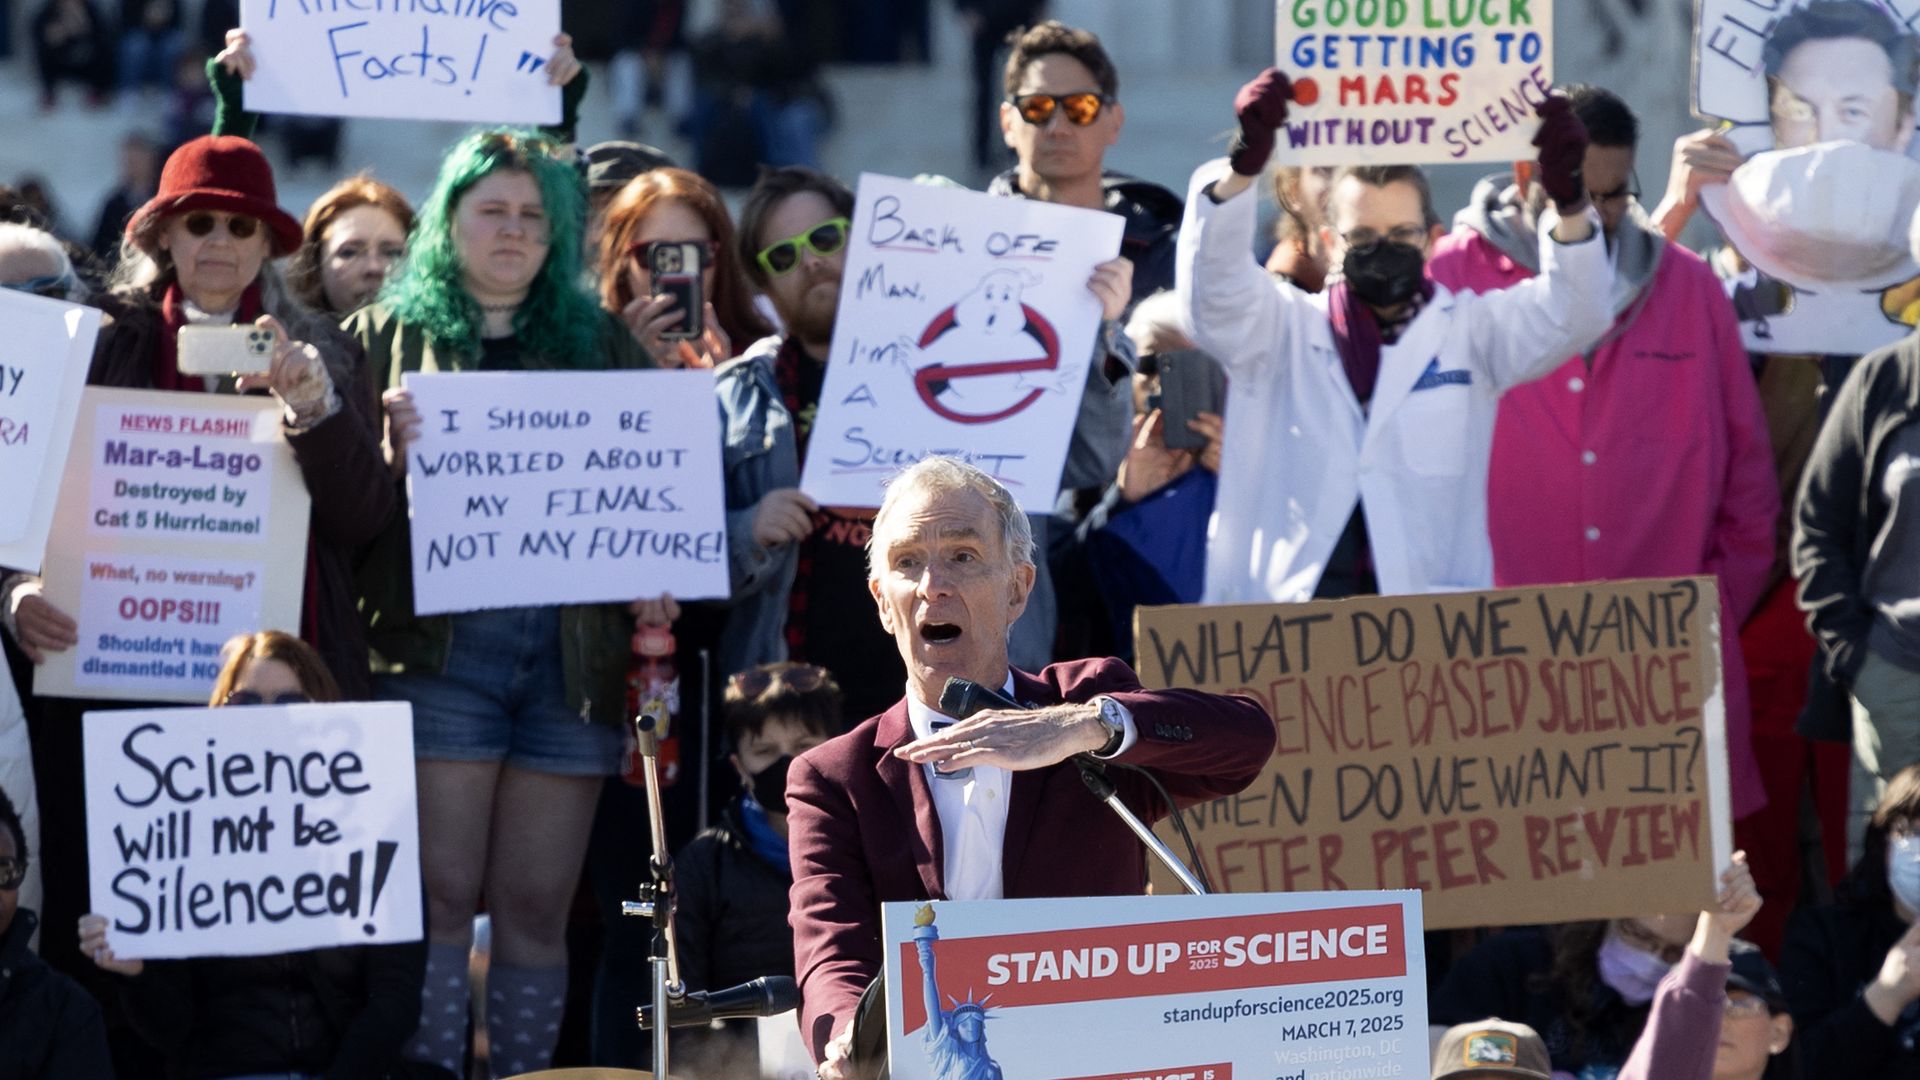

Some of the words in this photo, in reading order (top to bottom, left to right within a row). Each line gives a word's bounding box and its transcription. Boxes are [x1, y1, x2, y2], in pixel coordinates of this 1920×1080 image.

[268, 0, 518, 31] rnaive
[1291, 0, 1408, 28] GOOD
[1423, 0, 1532, 28] LUCK
[327, 21, 488, 98] Facts!
[1291, 33, 1476, 68] GETTING
[1495, 31, 1543, 64] TO
[1339, 72, 1461, 107] MARS
[1285, 117, 1435, 149] WITHOUT
[1444, 64, 1553, 158] SCIENCE
[0, 364, 24, 397] Y
[841, 384, 878, 408] A
[120, 414, 174, 432] NEWS
[179, 416, 249, 436] FLASH!!
[440, 409, 461, 433] I
[487, 408, 592, 432] SHOULD
[619, 409, 653, 433] BE
[104, 441, 262, 476] Mar-a-Lago
[416, 451, 565, 478] WORRIED
[584, 448, 688, 472] ABOUT
[114, 480, 217, 505] Destroyed
[223, 485, 248, 507] by
[465, 494, 510, 519] MY
[545, 485, 684, 517] FINALS.
[94, 509, 129, 528] Cat
[135, 511, 148, 529] 5
[154, 511, 261, 534] Hurricane!
[426, 531, 503, 573] NOT
[519, 530, 577, 561] MY
[586, 526, 725, 563] FUTURE!
[90, 562, 140, 584] What,
[146, 568, 168, 583] no
[173, 569, 256, 592] warning?
[118, 595, 222, 625] OOPS!!!
[98, 633, 185, 656] Shouldn't
[191, 637, 224, 657] hav
[1148, 611, 1333, 687] WHAT
[1351, 607, 1416, 668] DO
[1435, 597, 1528, 659] WE
[1537, 580, 1701, 657] WANT?
[83, 656, 187, 679] dismantled
[1400, 657, 1531, 746] BASED
[1538, 652, 1702, 735] SCIENCE
[113, 722, 371, 808] Science
[1336, 764, 1402, 823] DO
[1412, 756, 1482, 816] WE
[1488, 742, 1622, 809] WANT
[1628, 726, 1702, 795] IT?
[113, 809, 191, 866] will
[212, 805, 275, 856] not
[294, 803, 343, 847] be
[1371, 817, 1508, 893] PEER
[1524, 799, 1702, 882] REVIEW
[111, 841, 399, 937] Silenced!
[986, 947, 1119, 987] STAND
[1127, 942, 1181, 976] UP
[1187, 940, 1221, 955] FOR
[1223, 924, 1388, 968] SCIENCE
[1189, 958, 1219, 971] 2025
[1163, 986, 1404, 1025] standupforscience2025.org
[1282, 1020, 1341, 1041] MARCH
[1345, 1019, 1357, 1038] 7,
[1360, 1014, 1404, 1034] 2025
[1274, 1044, 1376, 1065] Washington,
[1379, 1037, 1401, 1056] DC
